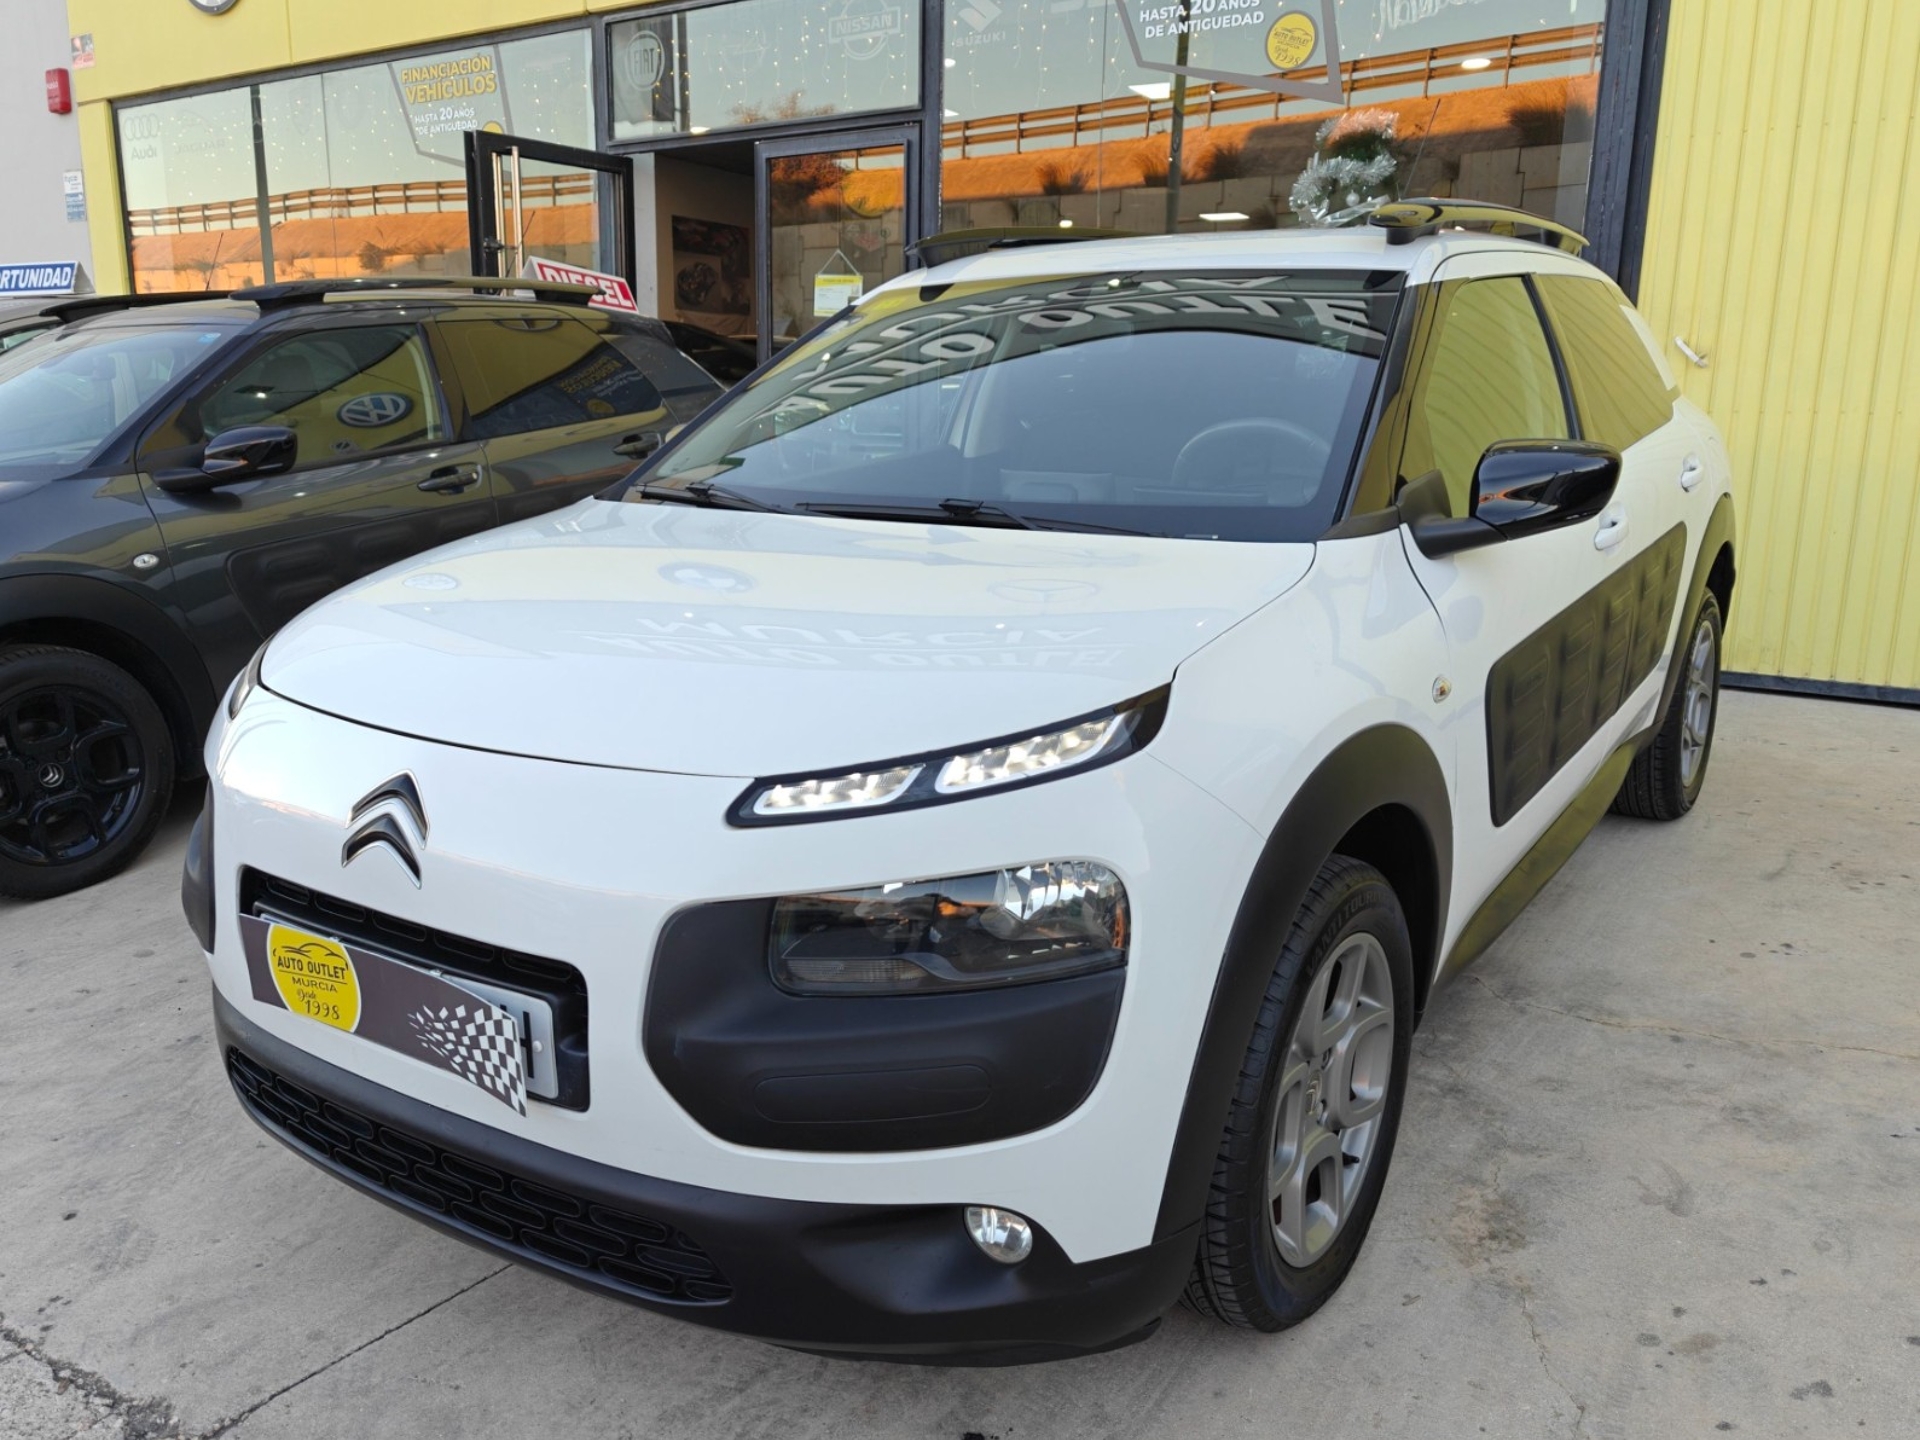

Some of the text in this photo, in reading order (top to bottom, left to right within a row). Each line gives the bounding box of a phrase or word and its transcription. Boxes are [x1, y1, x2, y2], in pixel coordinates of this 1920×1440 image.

[1139, 5, 1185, 23] HASTA
[1189, 0, 1216, 15] 20
[835, 13, 893, 36] NISSAN
[1145, 10, 1265, 39] DE ANTIGUEDAD
[955, 31, 1007, 48] SUZUKI
[401, 54, 492, 84] FINANCIACIÓN
[633, 47, 655, 75] FIAT
[405, 73, 498, 104] VEHÍCULOS
[415, 112, 438, 124] HASTA
[439, 107, 453, 121] 20
[419, 126, 429, 135] DE
[131, 145, 158, 161] Audi
[0, 266, 72, 289] RTUNIDAD
[277, 955, 346, 980] AUTO OUTLET
[292, 976, 338, 993] MURCIA
[305, 999, 340, 1020] 1998
